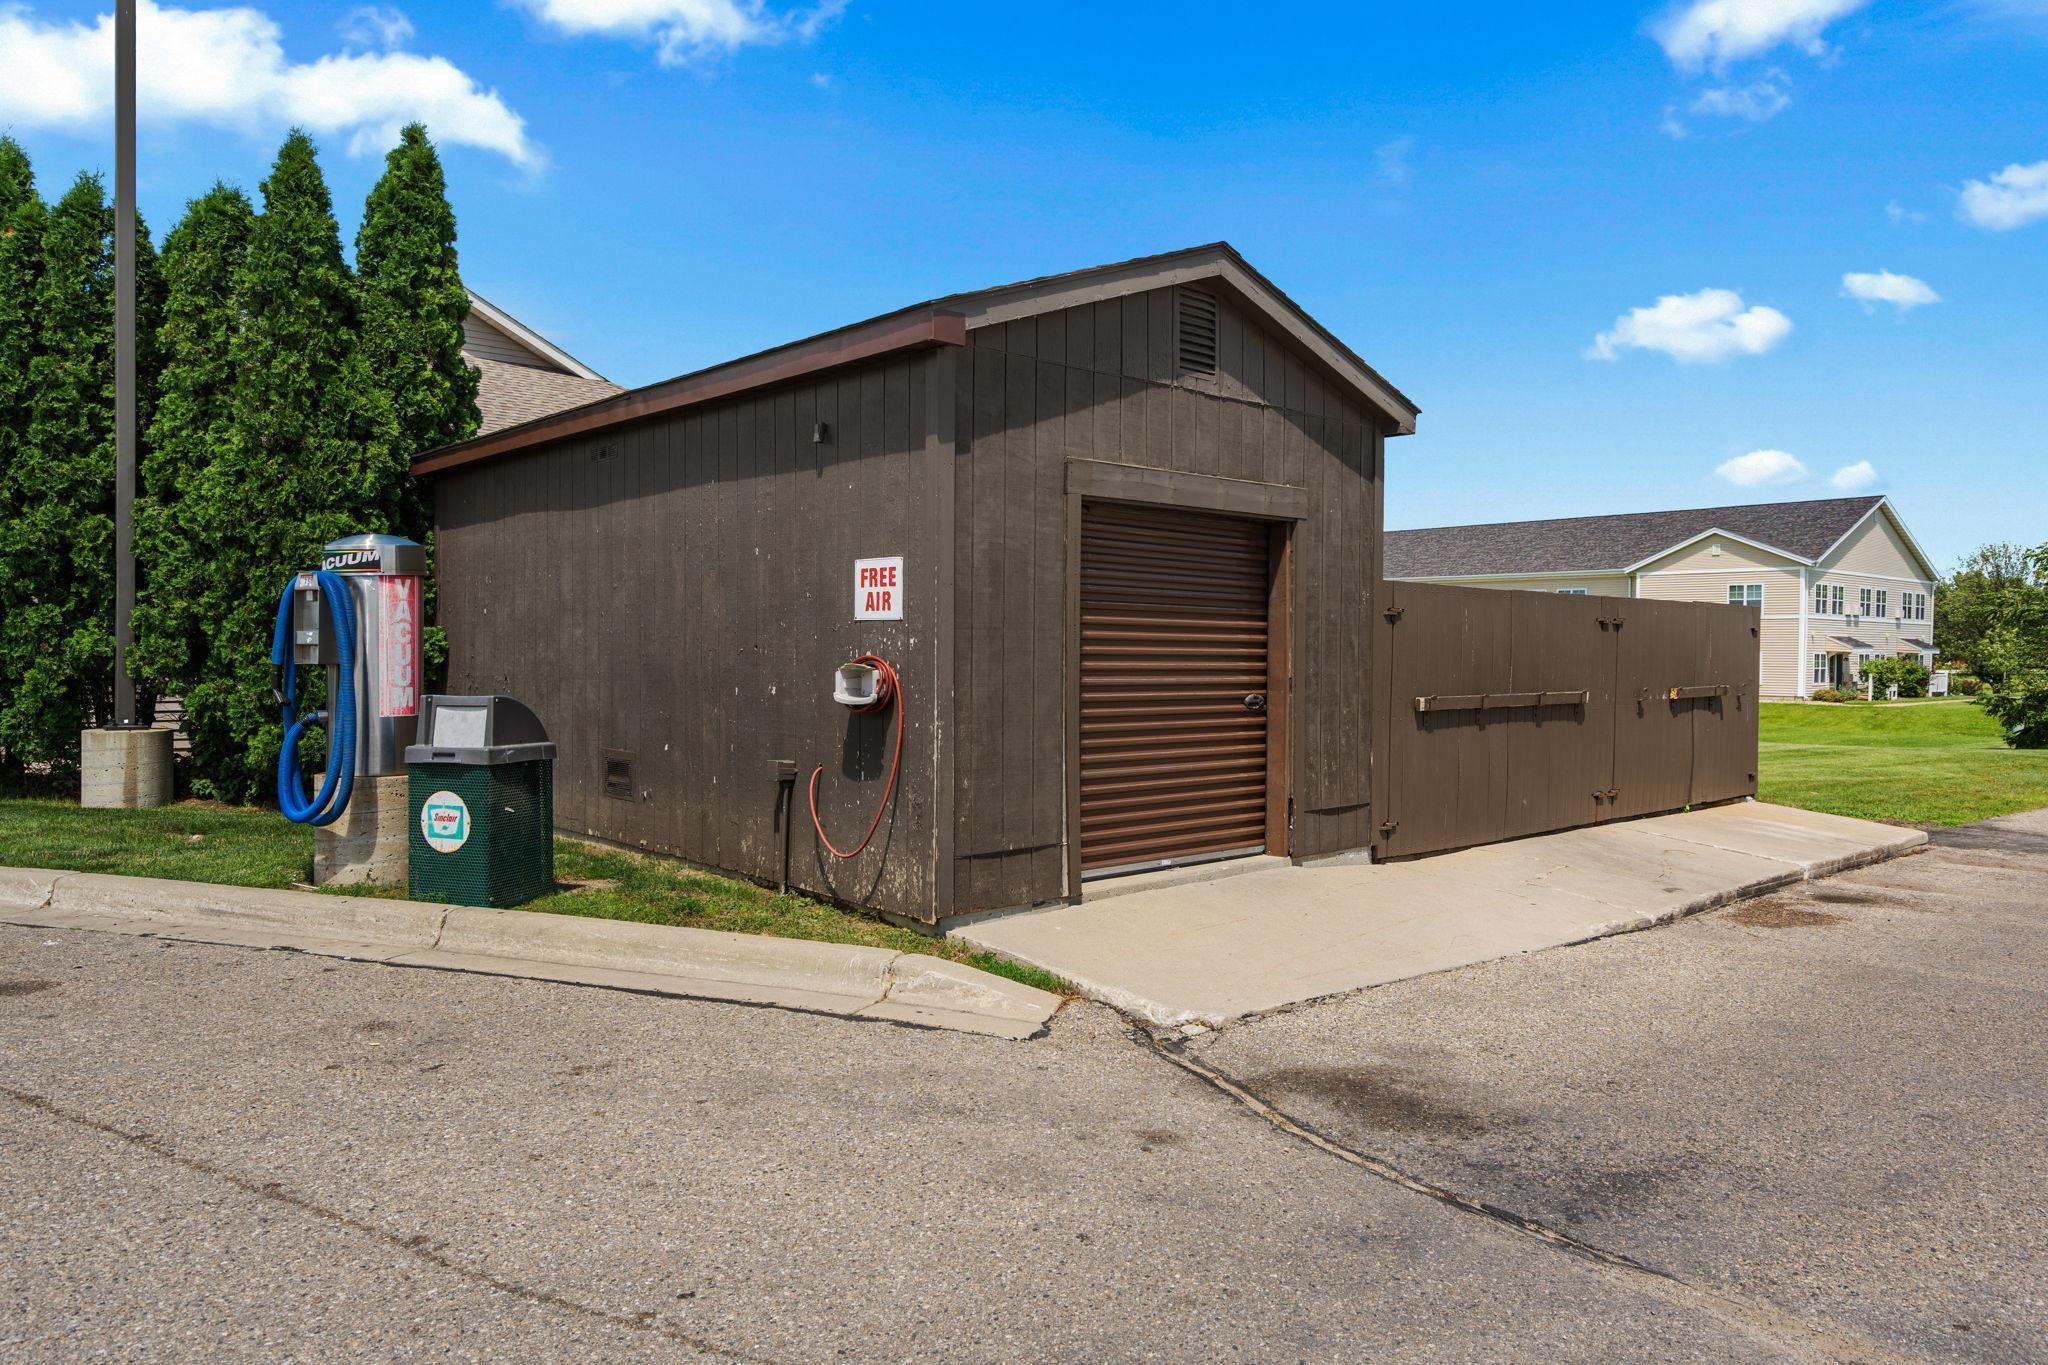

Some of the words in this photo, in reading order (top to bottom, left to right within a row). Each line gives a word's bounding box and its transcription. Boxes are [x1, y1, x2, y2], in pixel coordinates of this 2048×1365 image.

[861, 567, 896, 588] FREE
[865, 591, 891, 611] AIR
[393, 579, 413, 706] VACUUM
[434, 813, 458, 822] Sinclair
